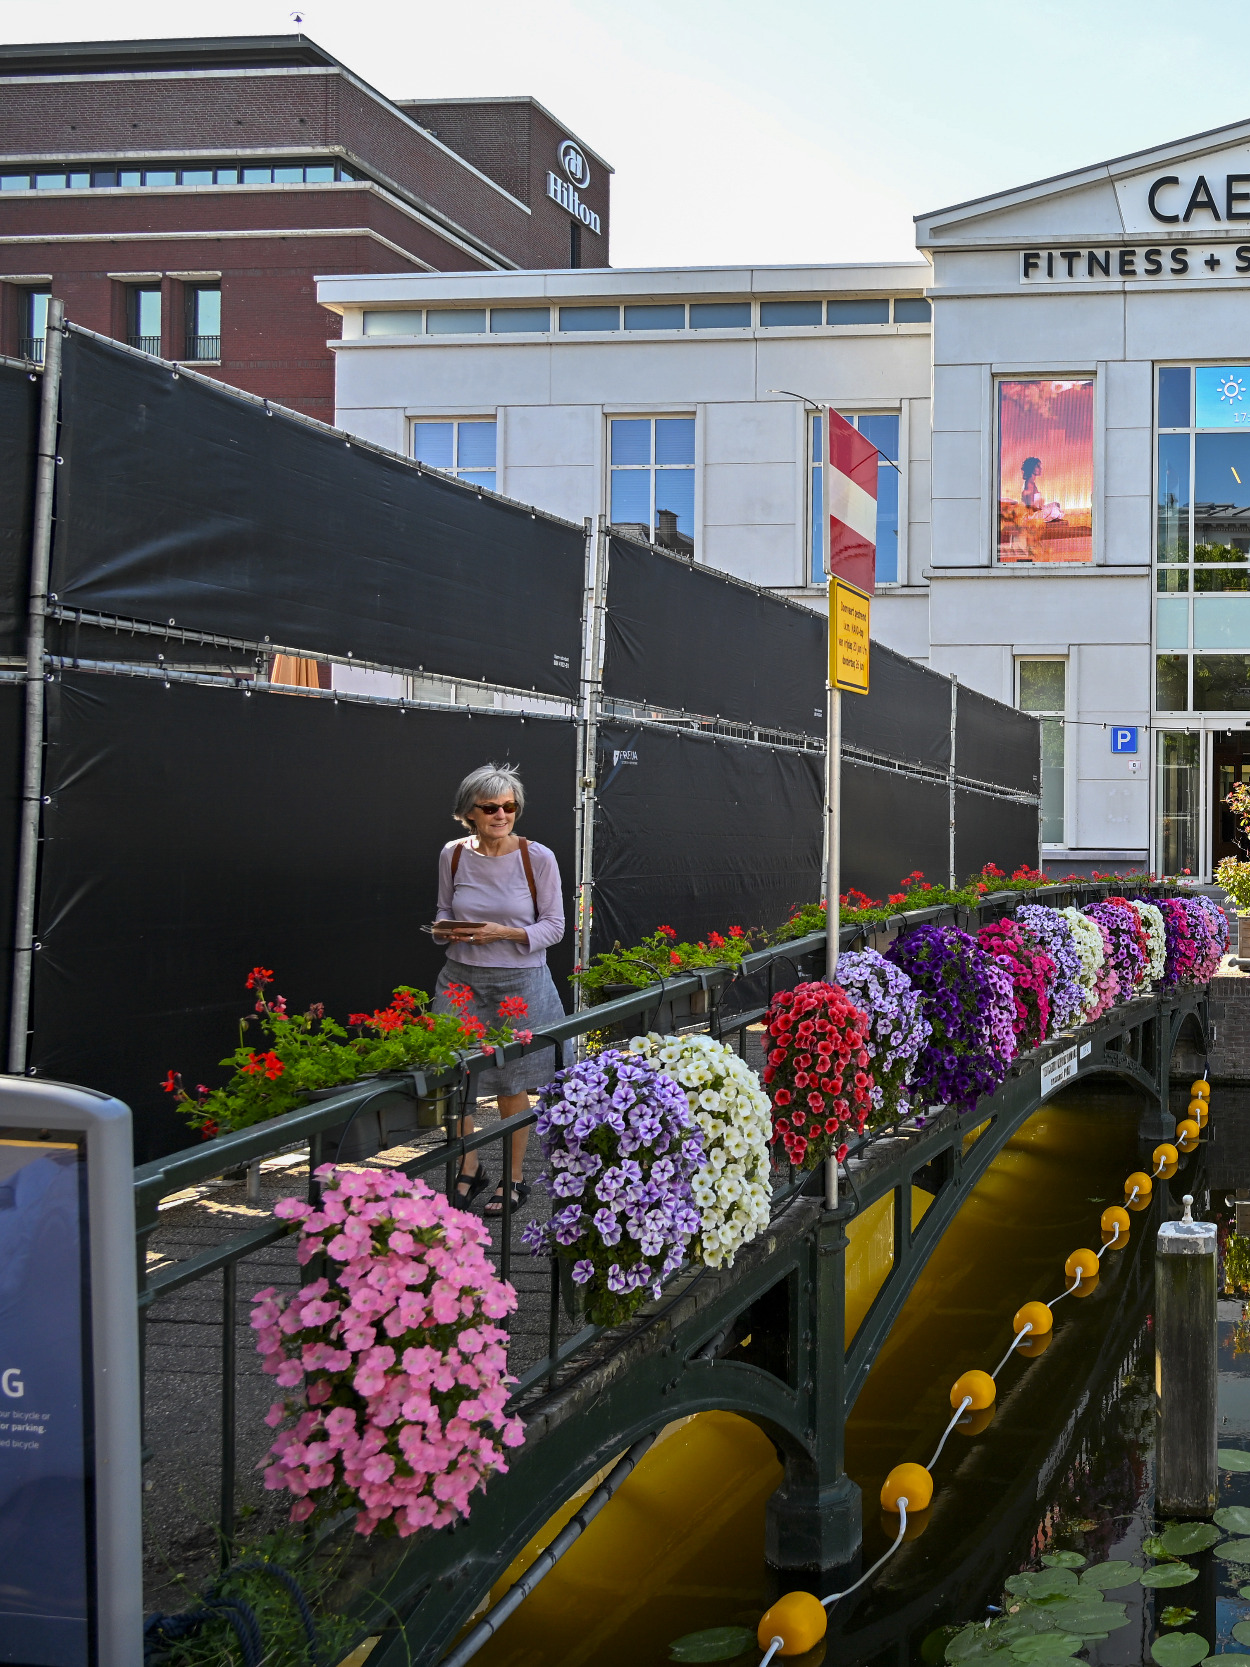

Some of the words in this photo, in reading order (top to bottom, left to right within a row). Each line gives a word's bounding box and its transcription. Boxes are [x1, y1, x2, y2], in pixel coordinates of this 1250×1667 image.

[546, 170, 601, 235] Hilton
[1023, 247, 1190, 279] FITNESS
[1203, 253, 1221, 272] +
[1117, 730, 1131, 750] P
[12, 1411, 40, 1421] bicycle
[11, 1423, 47, 1434] parking.
[12, 1440, 40, 1450] bicycle
